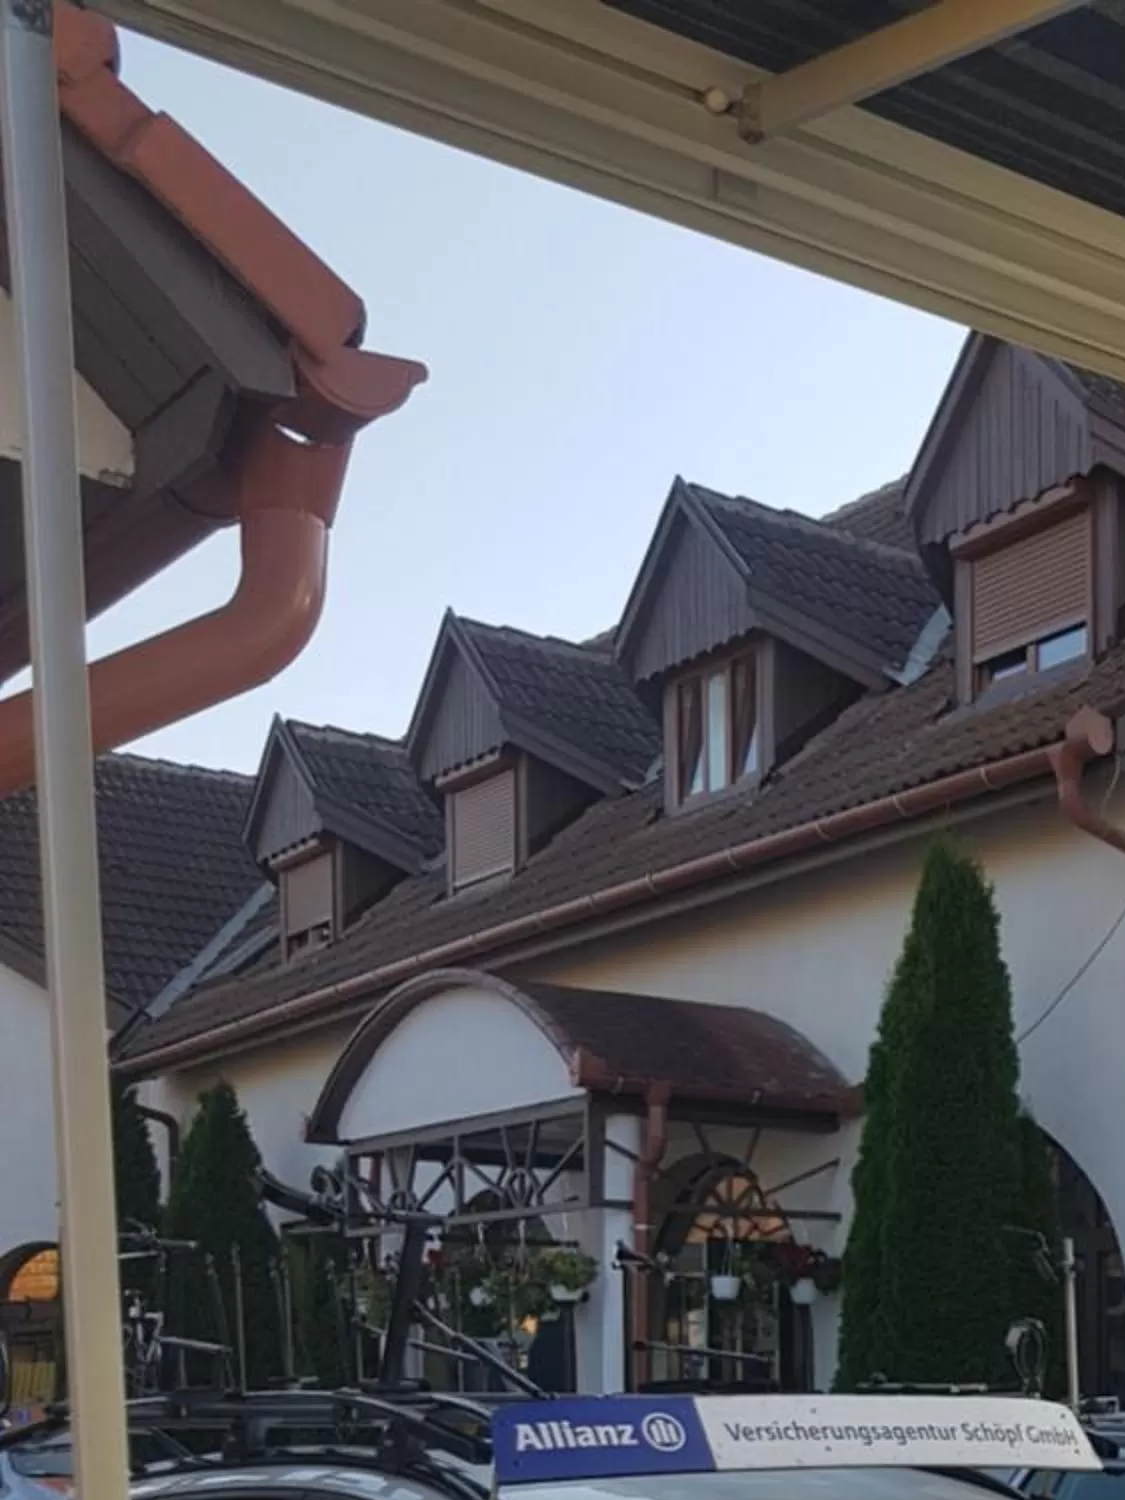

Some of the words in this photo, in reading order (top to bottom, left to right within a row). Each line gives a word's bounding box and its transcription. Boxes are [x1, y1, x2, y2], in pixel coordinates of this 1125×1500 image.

[514, 1420, 639, 1451] Allianz
[724, 1420, 958, 1446] Versicherungsagentur
[961, 1421, 1024, 1448] Schöpf
[1025, 1424, 1077, 1447] GmbH
